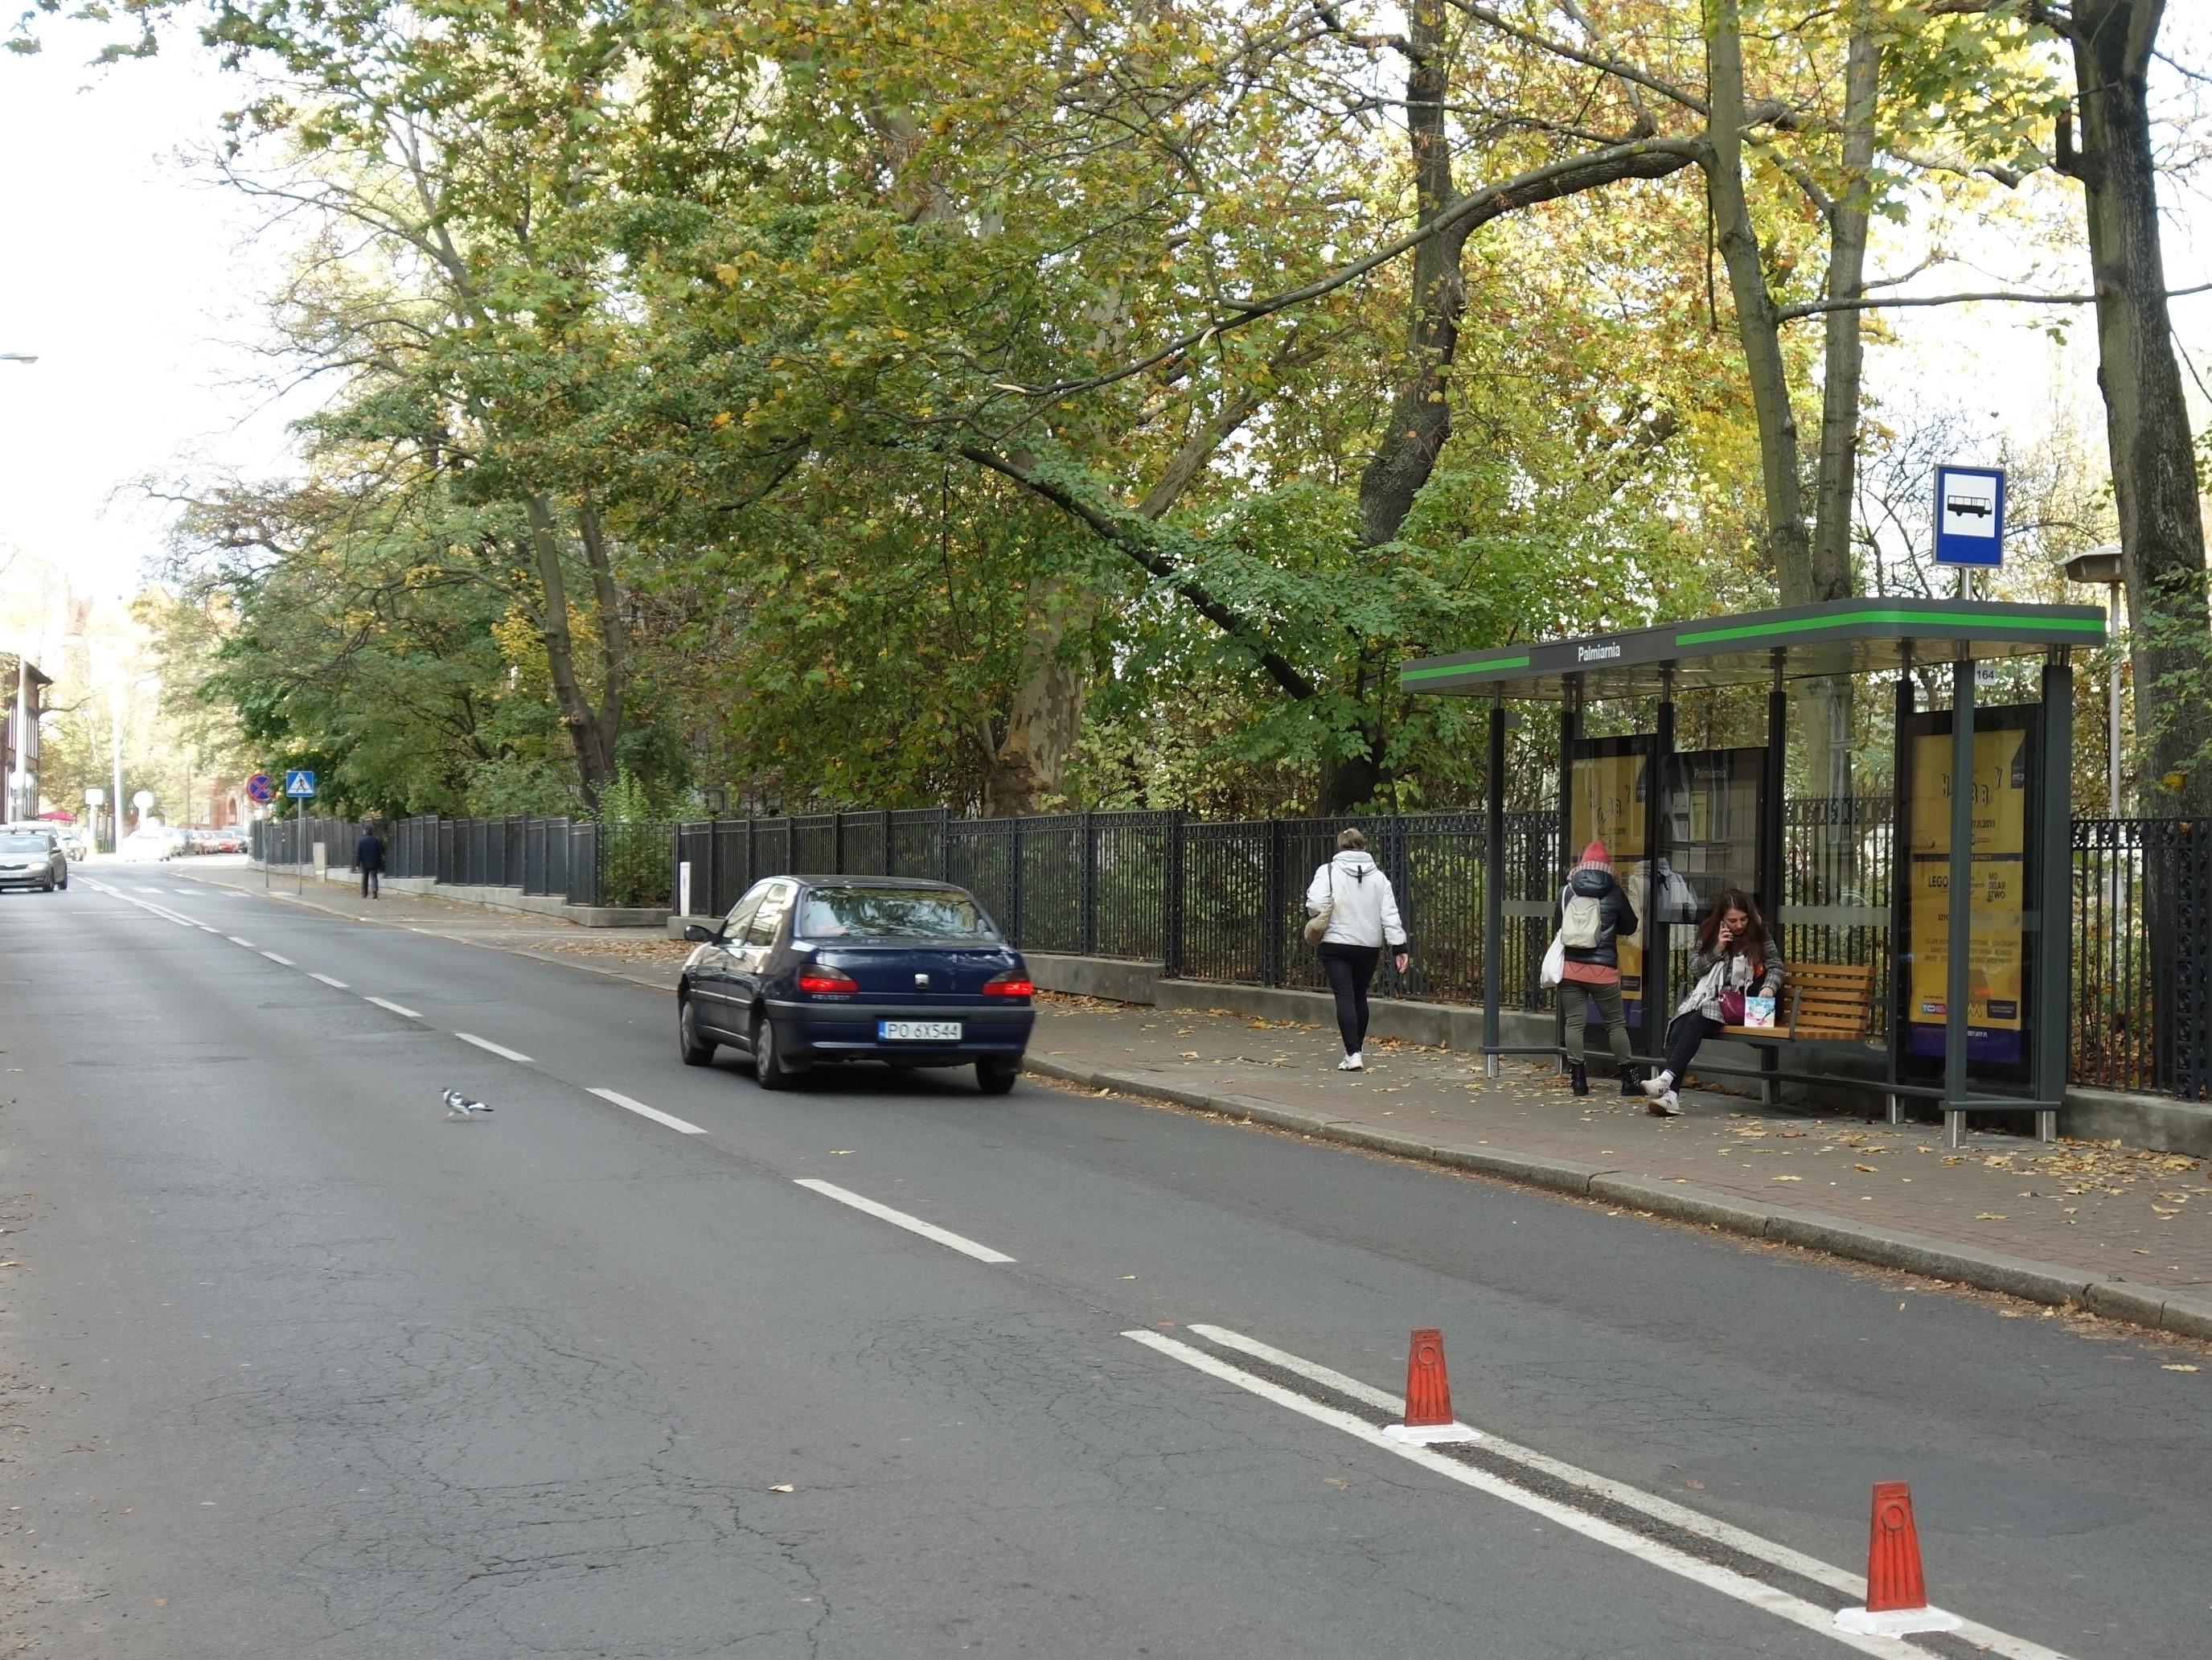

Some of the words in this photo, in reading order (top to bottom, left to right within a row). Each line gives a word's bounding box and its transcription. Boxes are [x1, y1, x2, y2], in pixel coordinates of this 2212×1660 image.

[1578, 641, 1621, 662] Palmiarnia
[1976, 669, 1994, 680] 164
[2012, 772, 2025, 782] mtp
[1942, 766, 2003, 807] HBBY
[1928, 875, 1949, 888] LEGO
[914, 1023, 958, 1038] 6X544
